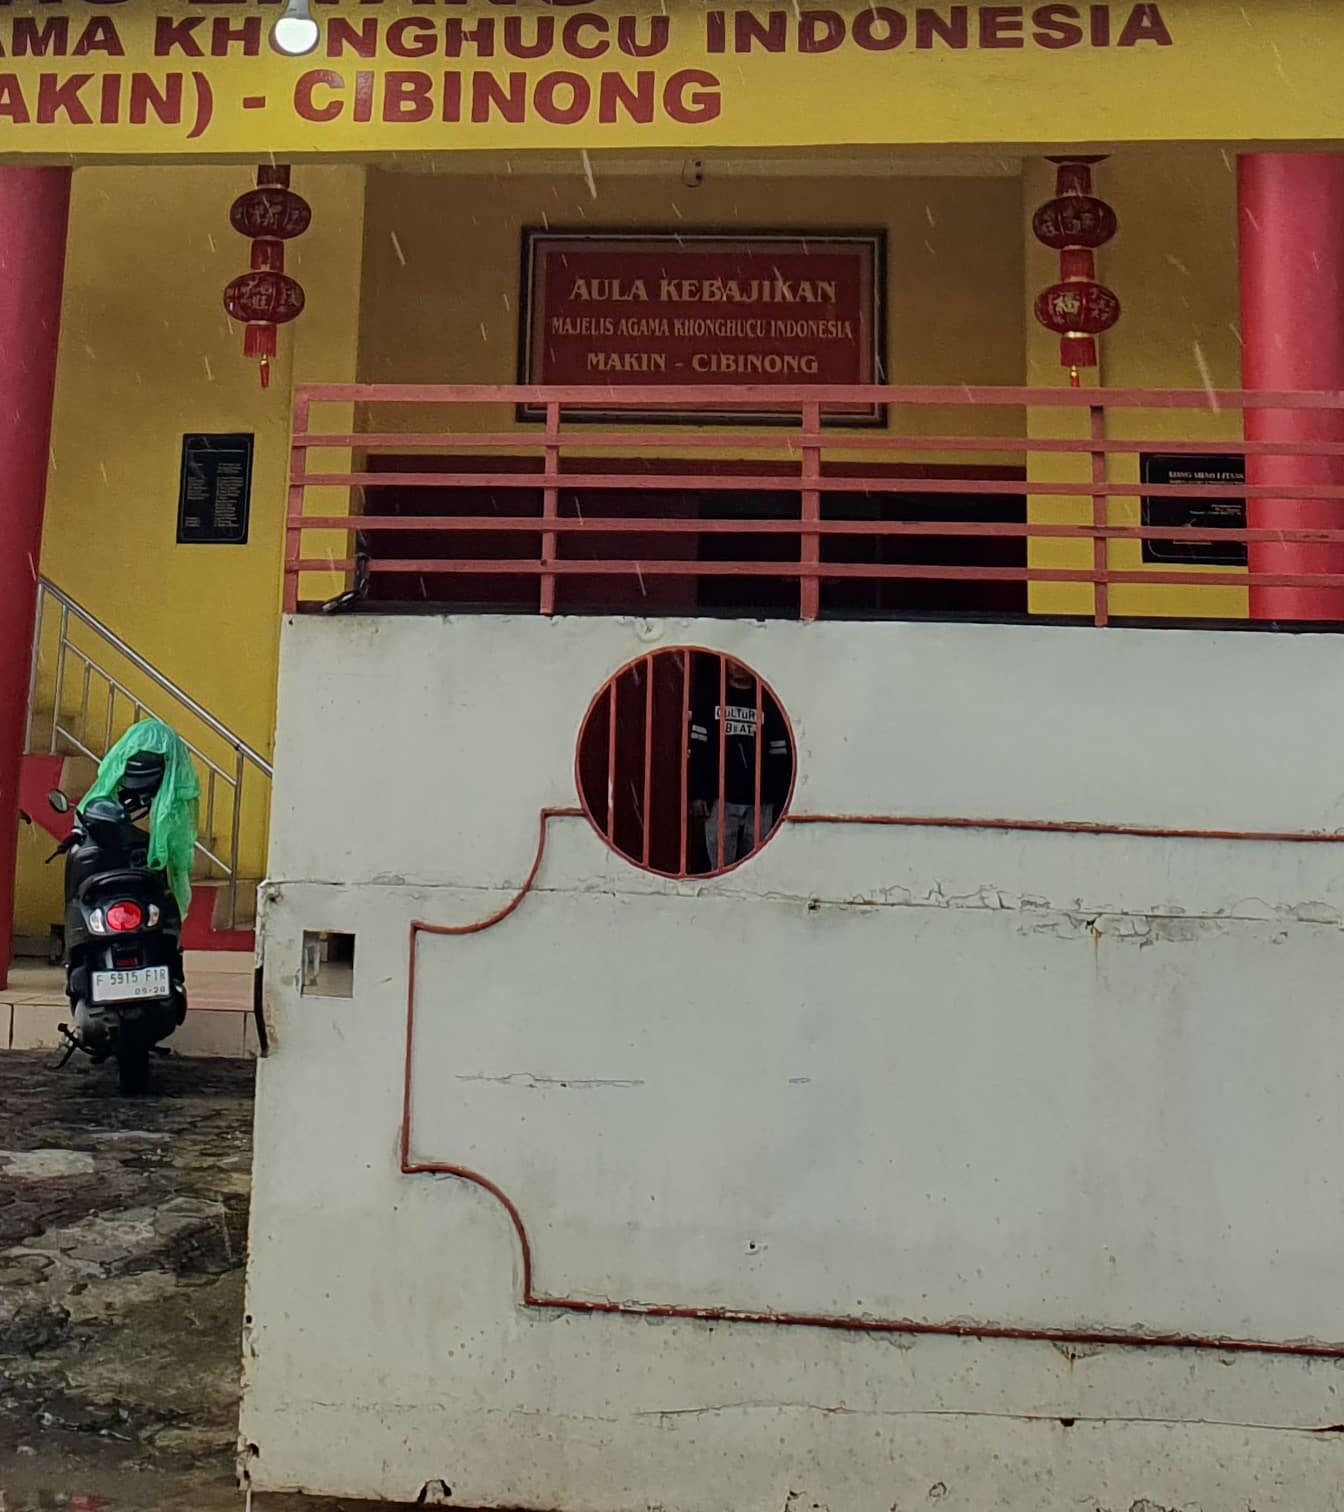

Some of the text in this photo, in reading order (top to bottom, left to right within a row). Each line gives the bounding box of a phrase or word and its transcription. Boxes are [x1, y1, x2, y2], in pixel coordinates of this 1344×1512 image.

[154, 13, 670, 59] KHNGHUCU
[706, 3, 1173, 54] INDONESIA
[242, 94, 267, 108] -
[293, 69, 722, 124] CIBINONG
[569, 278, 836, 303] AULA KEBAJIKAN
[552, 317, 854, 339] MAJELIS AGAMA KHONGHUCU INDONESIA
[587, 352, 666, 372] MAKIN
[692, 353, 818, 373] CIBINONG
[96, 975, 104, 986] F
[110, 972, 138, 985] 5915
